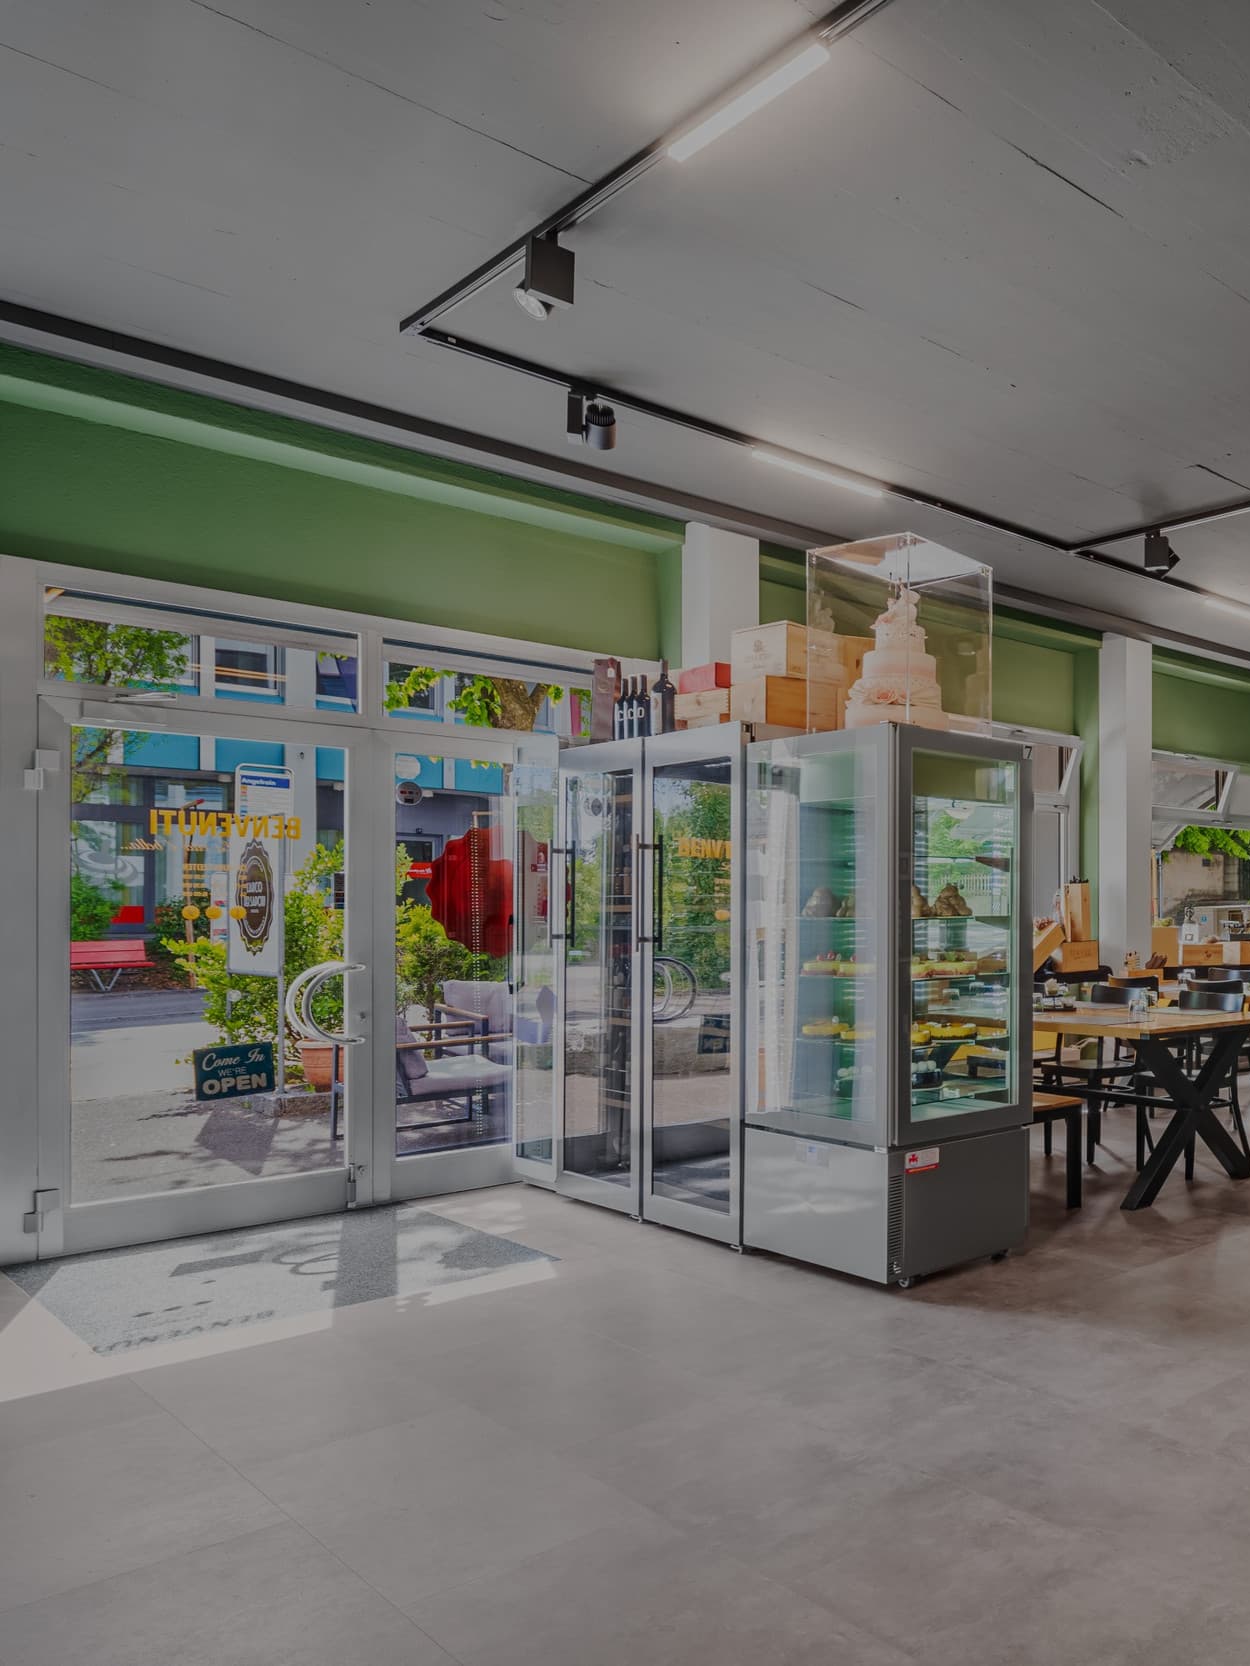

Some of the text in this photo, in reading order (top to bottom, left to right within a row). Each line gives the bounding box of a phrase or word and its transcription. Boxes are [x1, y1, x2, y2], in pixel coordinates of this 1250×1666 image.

[1025, 745, 1032, 759] 7
[202, 1047, 265, 1071] Come In
[217, 1066, 247, 1077] WE'RE
[202, 1072, 268, 1095] OPEN
